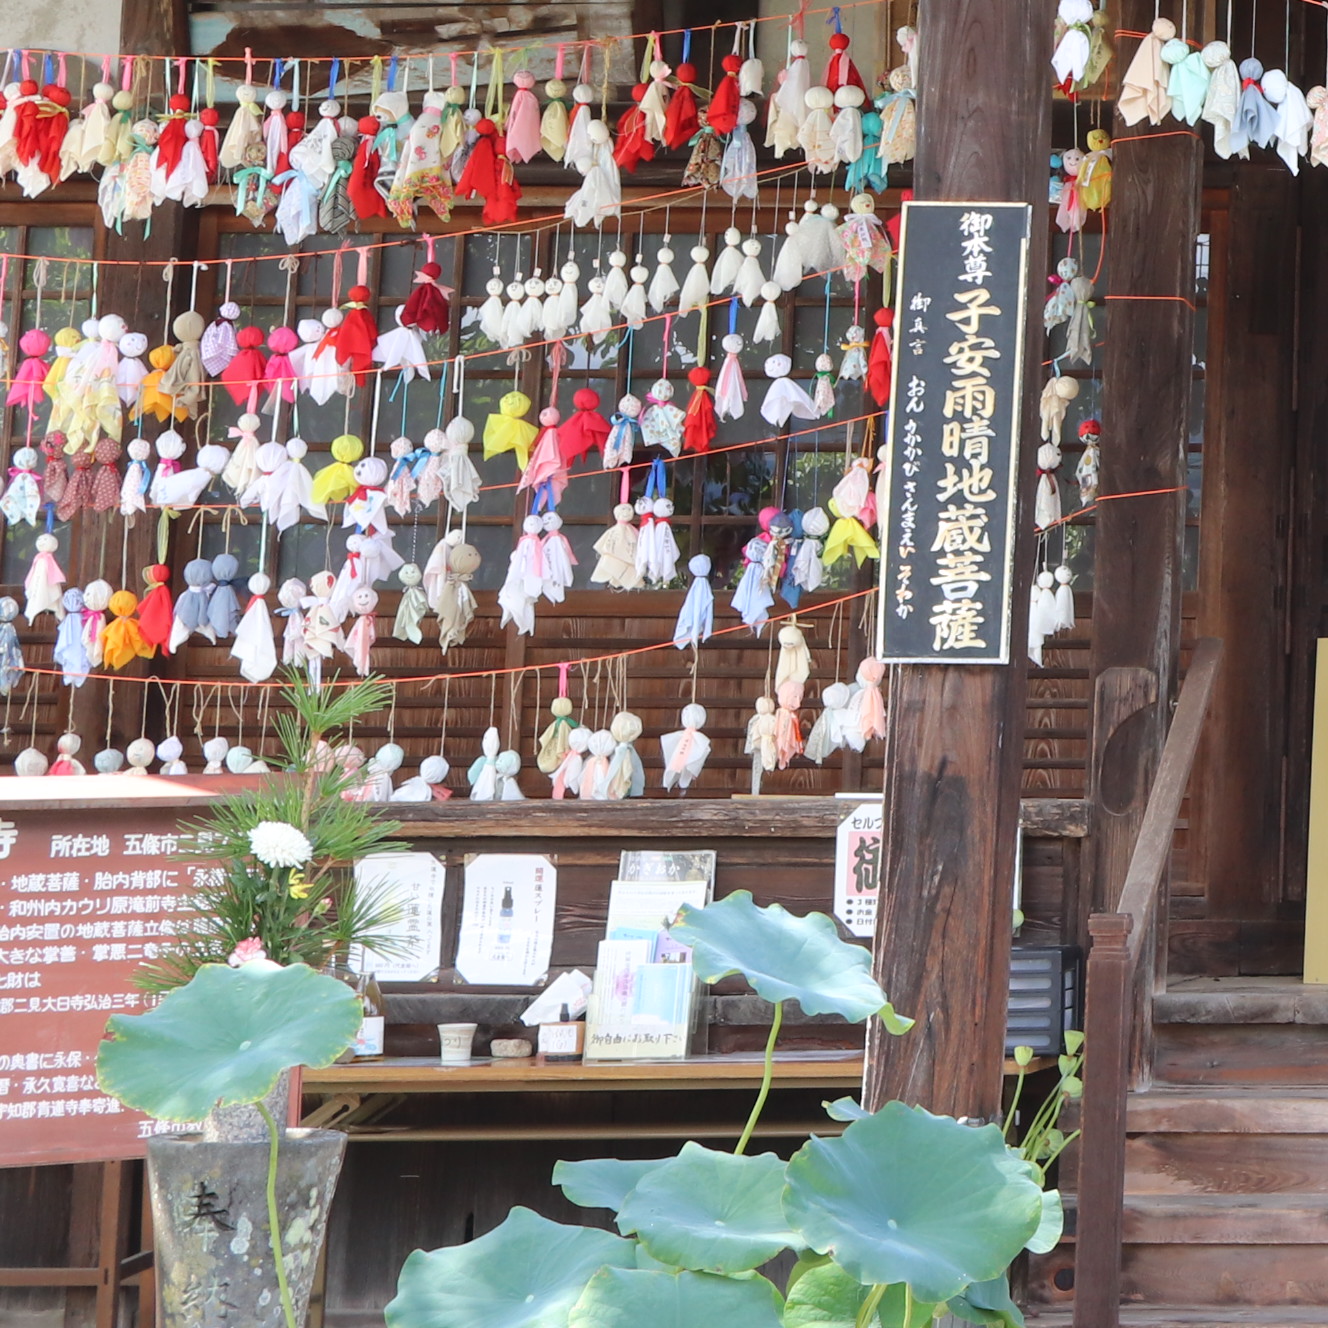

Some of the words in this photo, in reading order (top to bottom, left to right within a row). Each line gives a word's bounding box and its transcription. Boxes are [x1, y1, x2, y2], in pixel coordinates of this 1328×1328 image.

[957, 211, 994, 285] 御本尊
[907, 293, 931, 356] 御真言
[904, 374, 927, 415] おん
[930, 288, 1002, 652] 子安雨晴地蔵菩薩
[894, 563, 915, 620] そわか
[50, 833, 110, 858] 所在地
